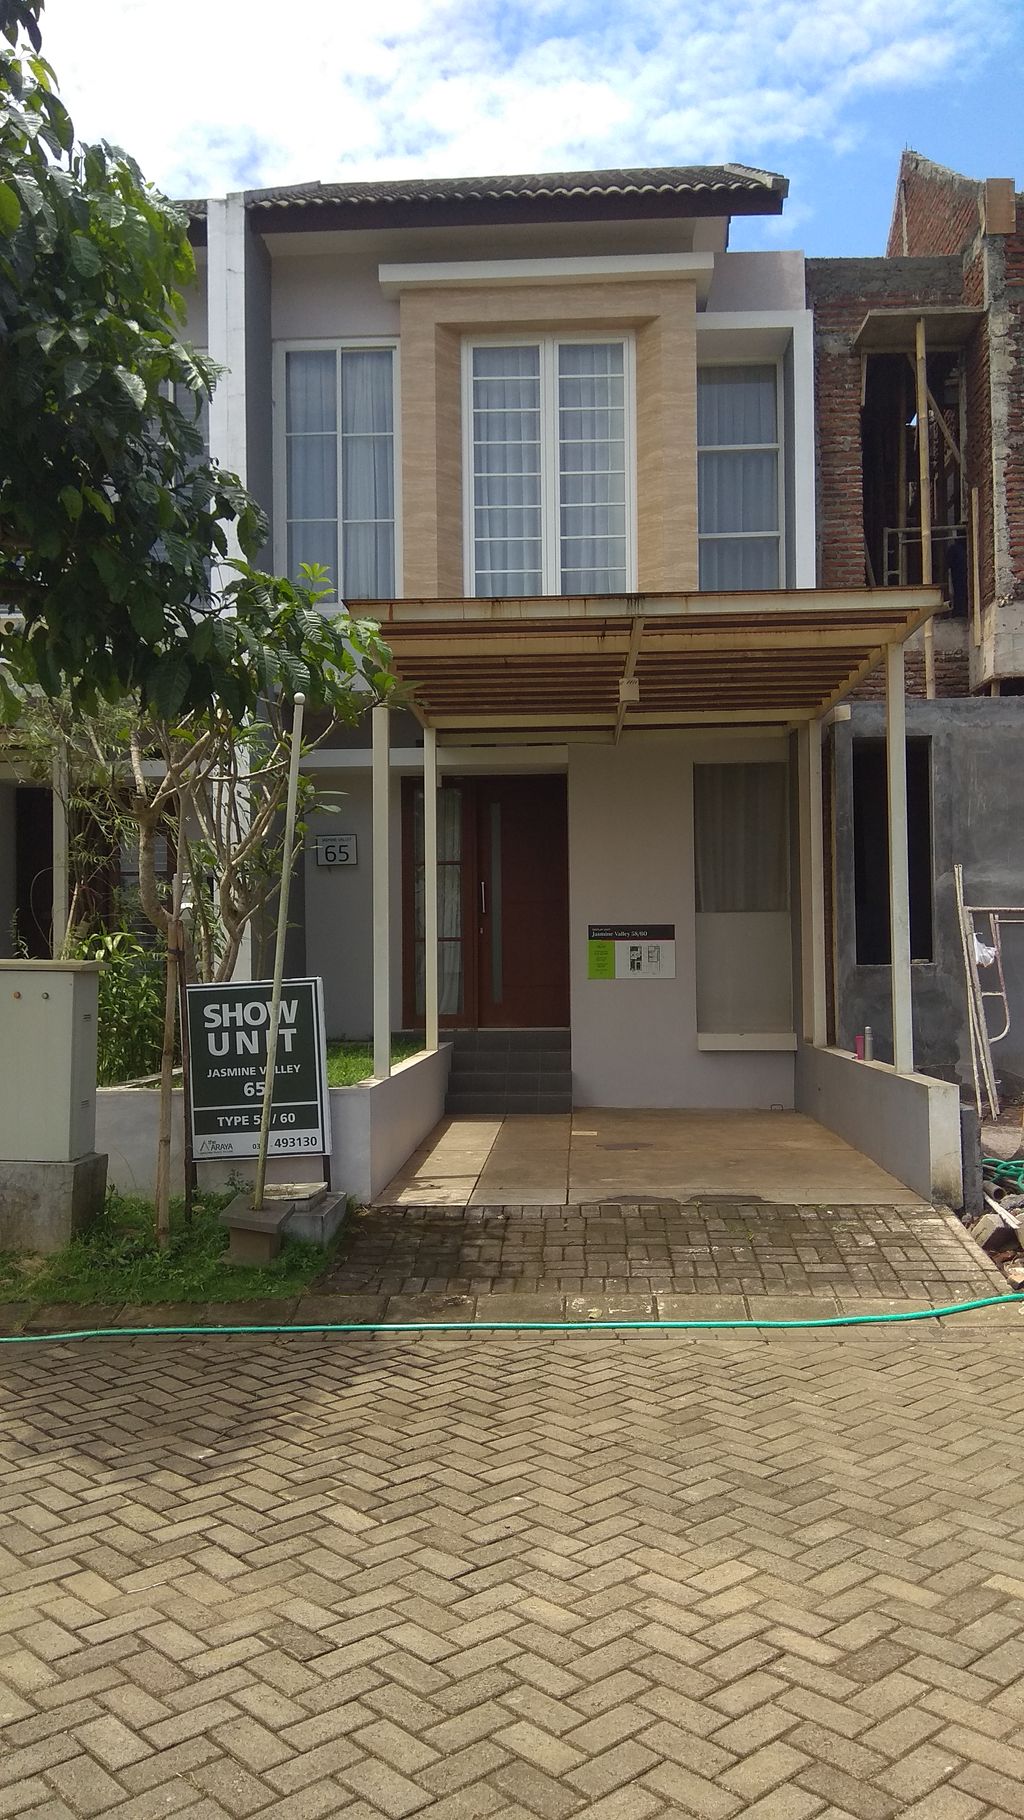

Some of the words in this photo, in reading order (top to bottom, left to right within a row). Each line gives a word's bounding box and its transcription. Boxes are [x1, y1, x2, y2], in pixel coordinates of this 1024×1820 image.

[325, 845, 349, 862] 65
[203, 1000, 299, 1028] SHOW
[207, 1066, 257, 1078] JASMINE
[259, 1064, 301, 1075] VLLEY
[243, 1081, 266, 1097] 65
[217, 1115, 250, 1127] TYPE
[253, 1114, 265, 1125] 5
[280, 1112, 296, 1124] 60
[210, 1143, 234, 1151] ARAYA
[274, 1136, 318, 1148] 493130
